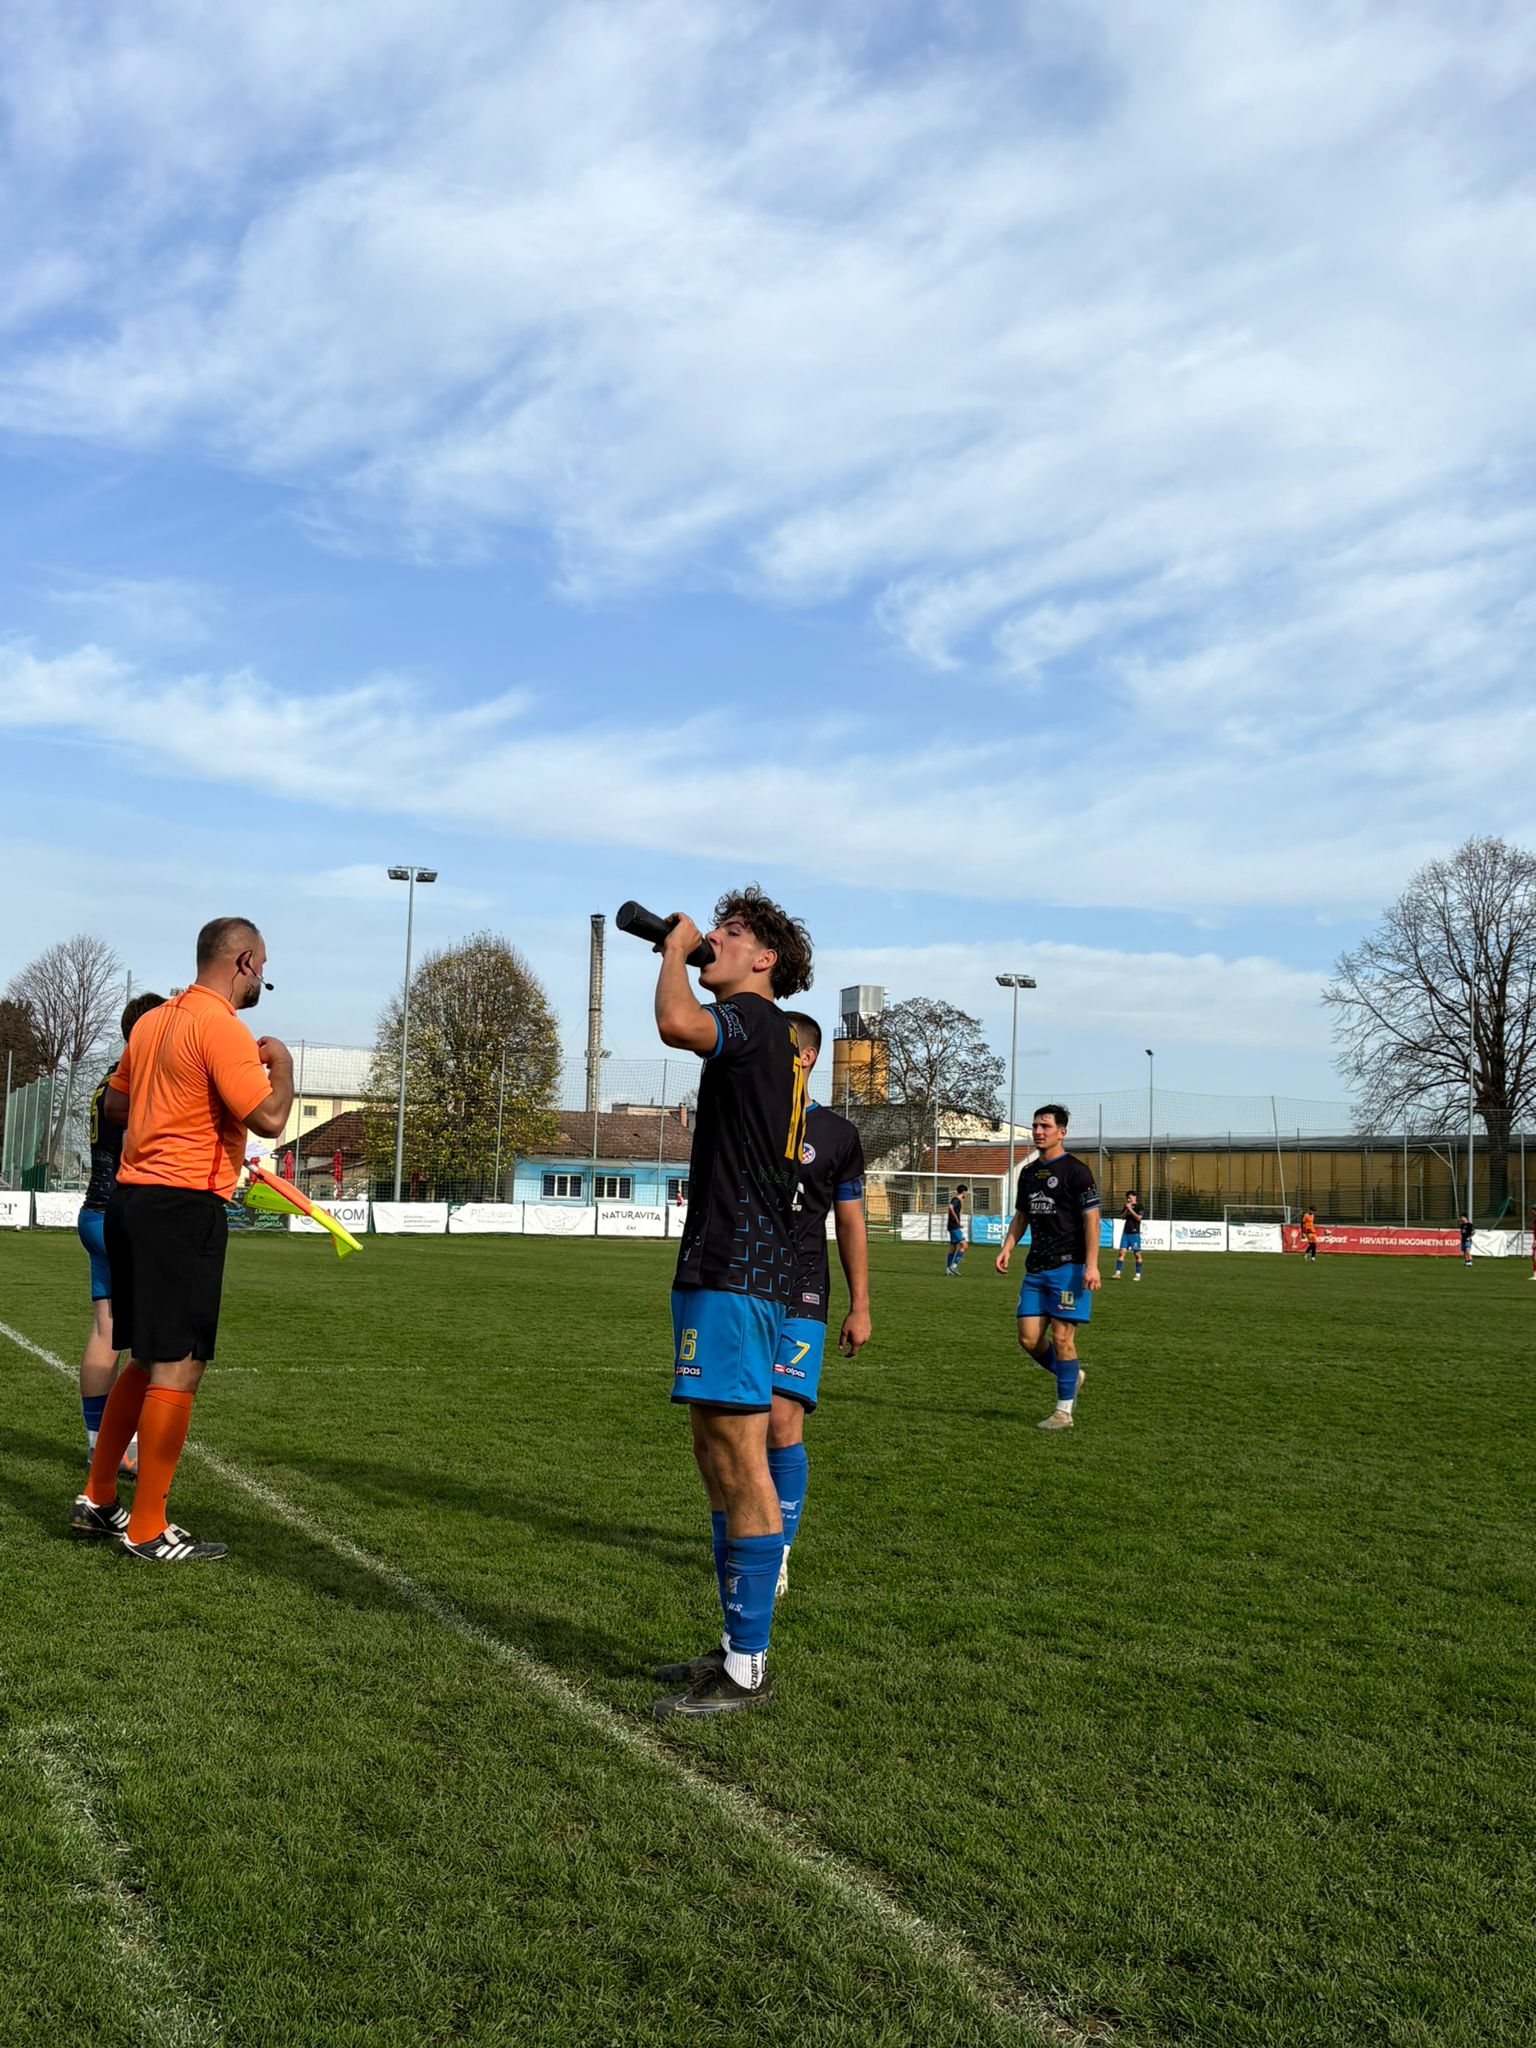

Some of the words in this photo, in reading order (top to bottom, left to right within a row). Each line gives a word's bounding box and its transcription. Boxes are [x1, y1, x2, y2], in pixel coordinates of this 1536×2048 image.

[326, 1208, 365, 1221] AKOM
[602, 1210, 661, 1221] NATURAVITA
[1360, 1236, 1397, 1246] HRVATSKI
[1398, 1238, 1444, 1247] NOGOMETNI
[1444, 1239, 1461, 1247] KUP
[680, 1328, 698, 1361] 6
[790, 1340, 811, 1365] 7
